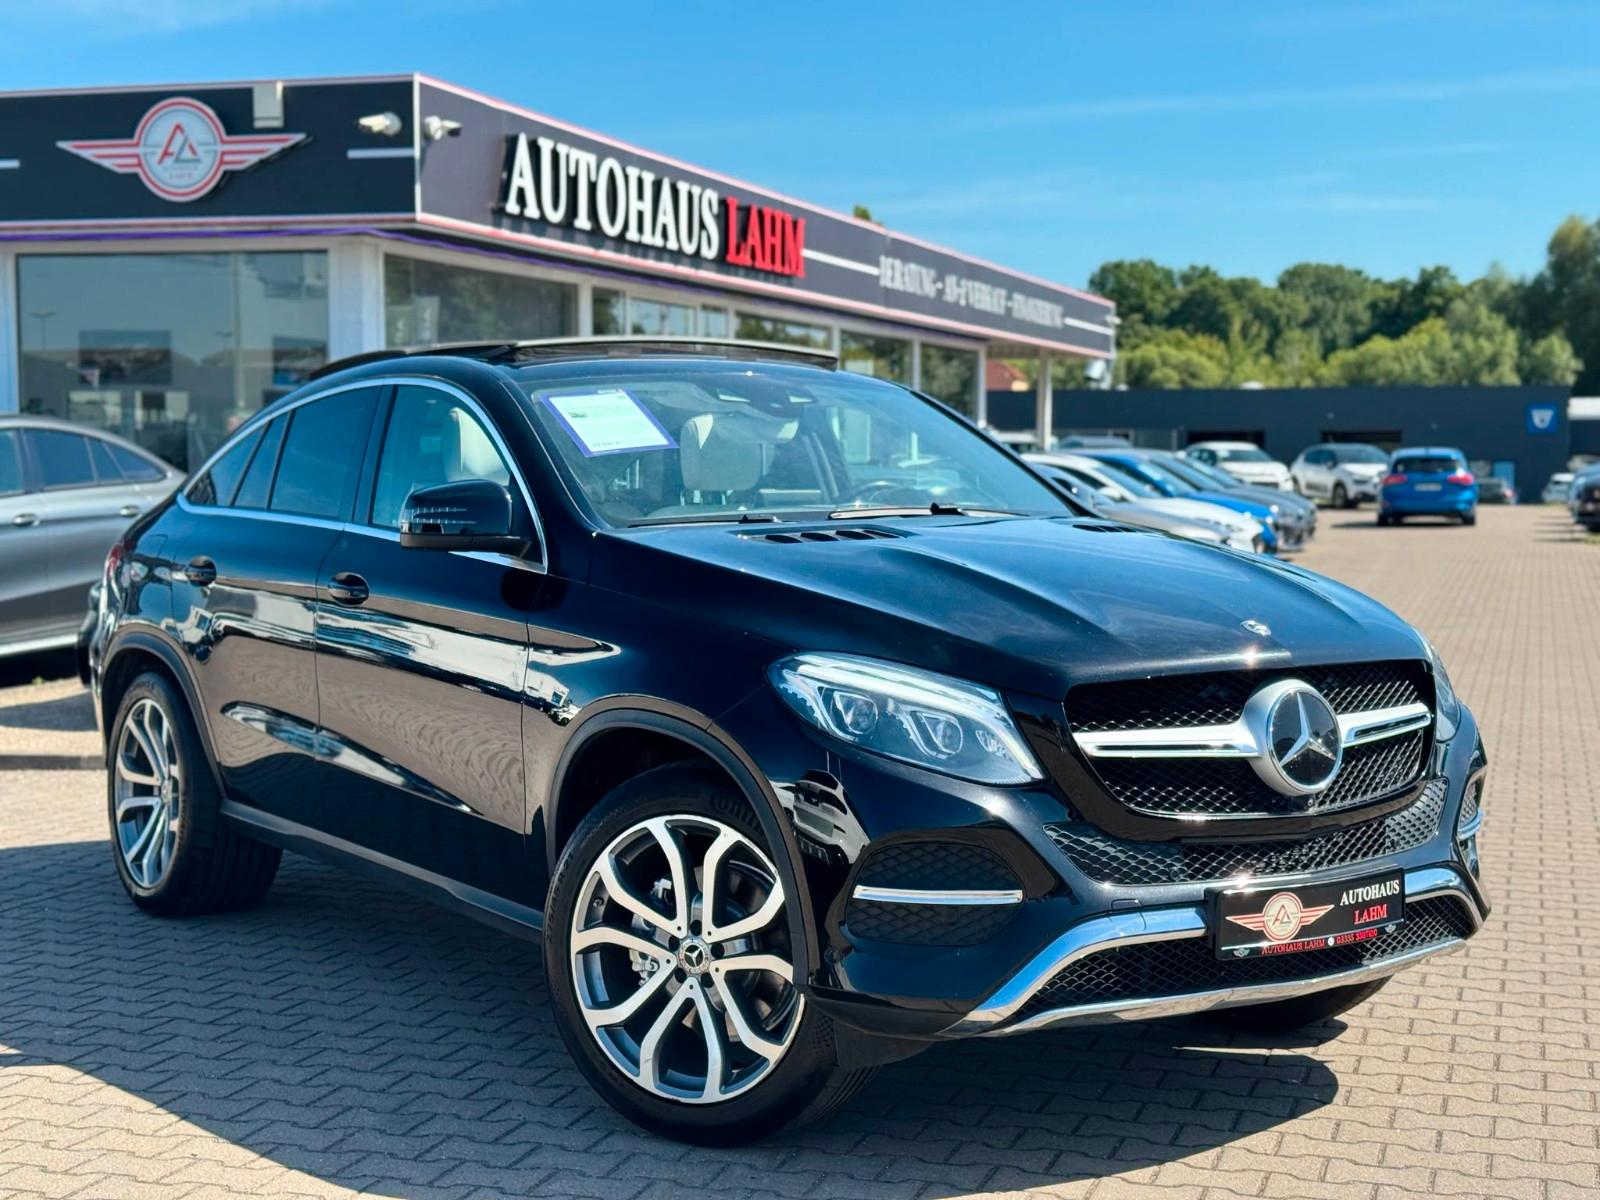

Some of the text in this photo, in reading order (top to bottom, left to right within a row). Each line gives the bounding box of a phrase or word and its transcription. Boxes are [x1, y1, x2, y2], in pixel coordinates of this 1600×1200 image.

[505, 132, 806, 277] AUTOHAUS LAHM
[1340, 879, 1400, 906] AUTOHAUS
[1353, 904, 1388, 925] LAHM
[1261, 943, 1303, 955] AUTOHAUS
[1304, 939, 1325, 950] LAHM
